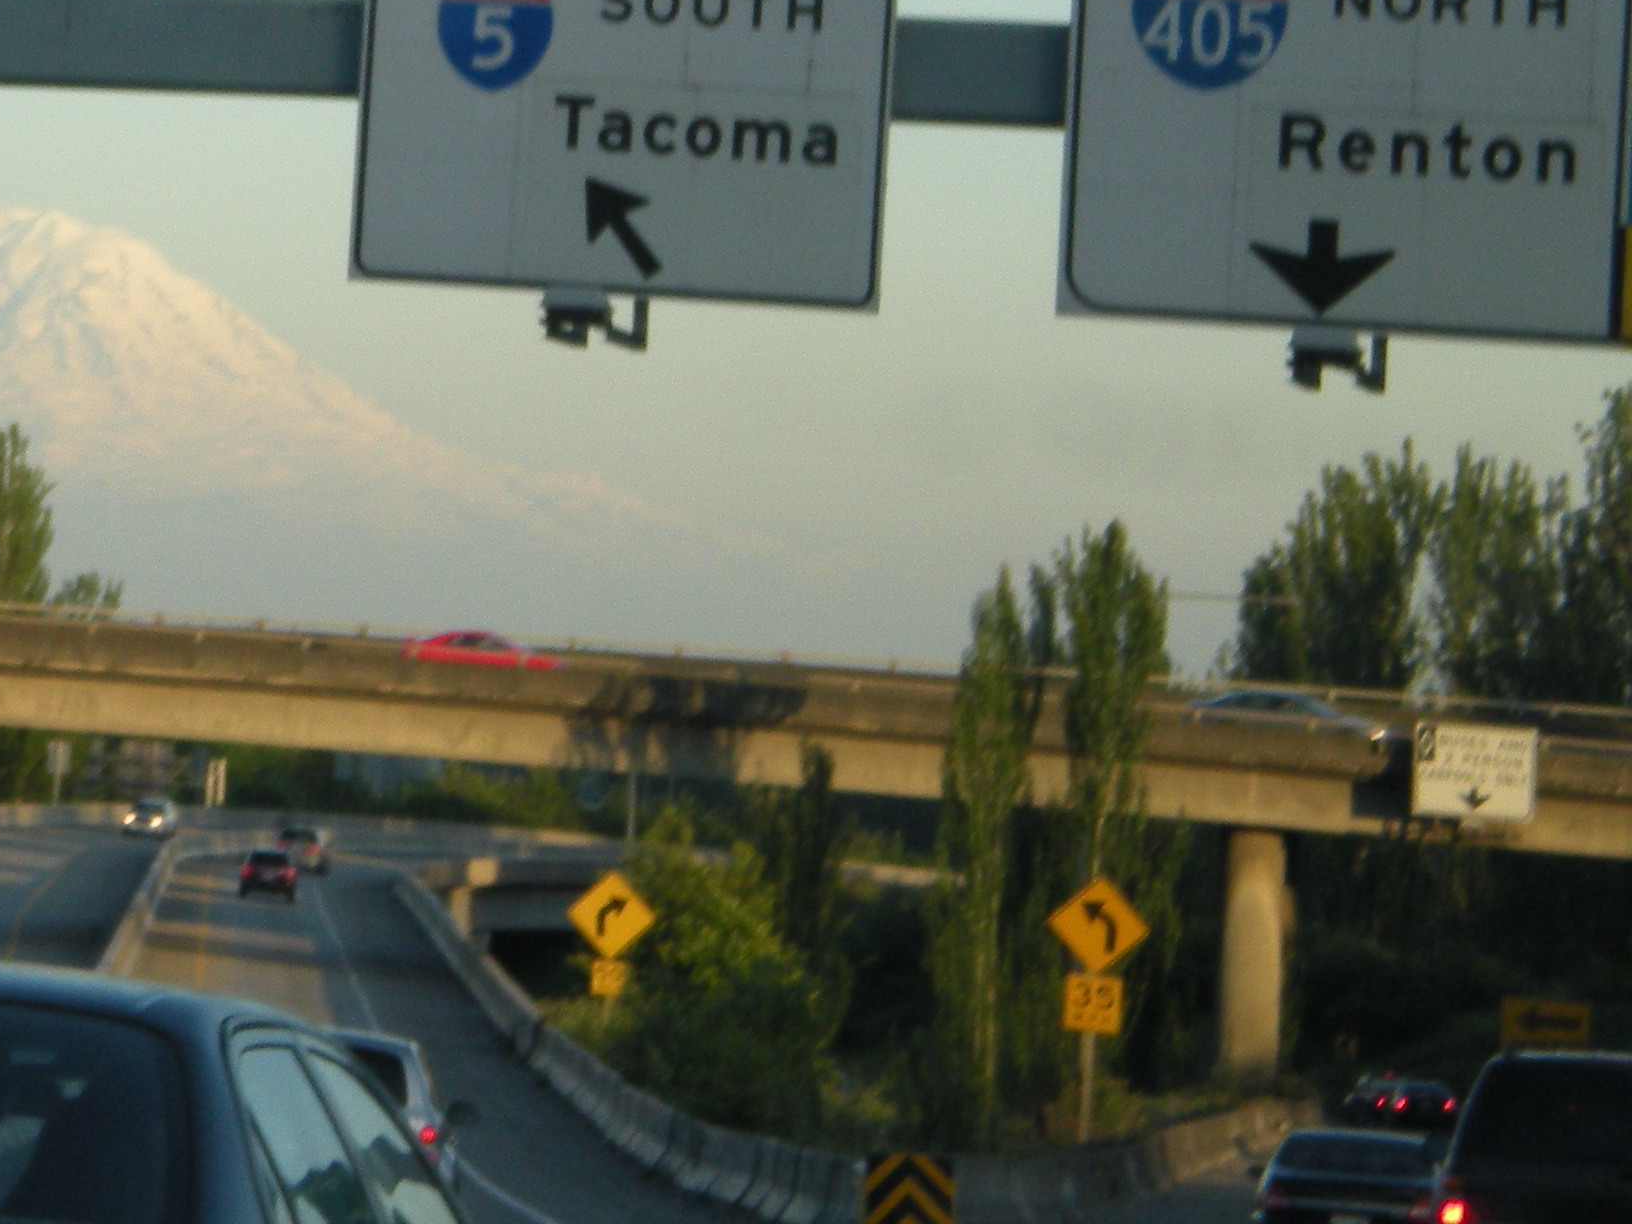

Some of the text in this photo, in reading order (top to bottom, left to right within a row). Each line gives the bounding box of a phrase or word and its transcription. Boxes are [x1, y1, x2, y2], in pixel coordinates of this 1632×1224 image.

[471, 5, 515, 71] 5
[554, 93, 838, 165] Tacoma
[1278, 112, 1577, 184] Renton
[1072, 981, 1115, 1010] 35
